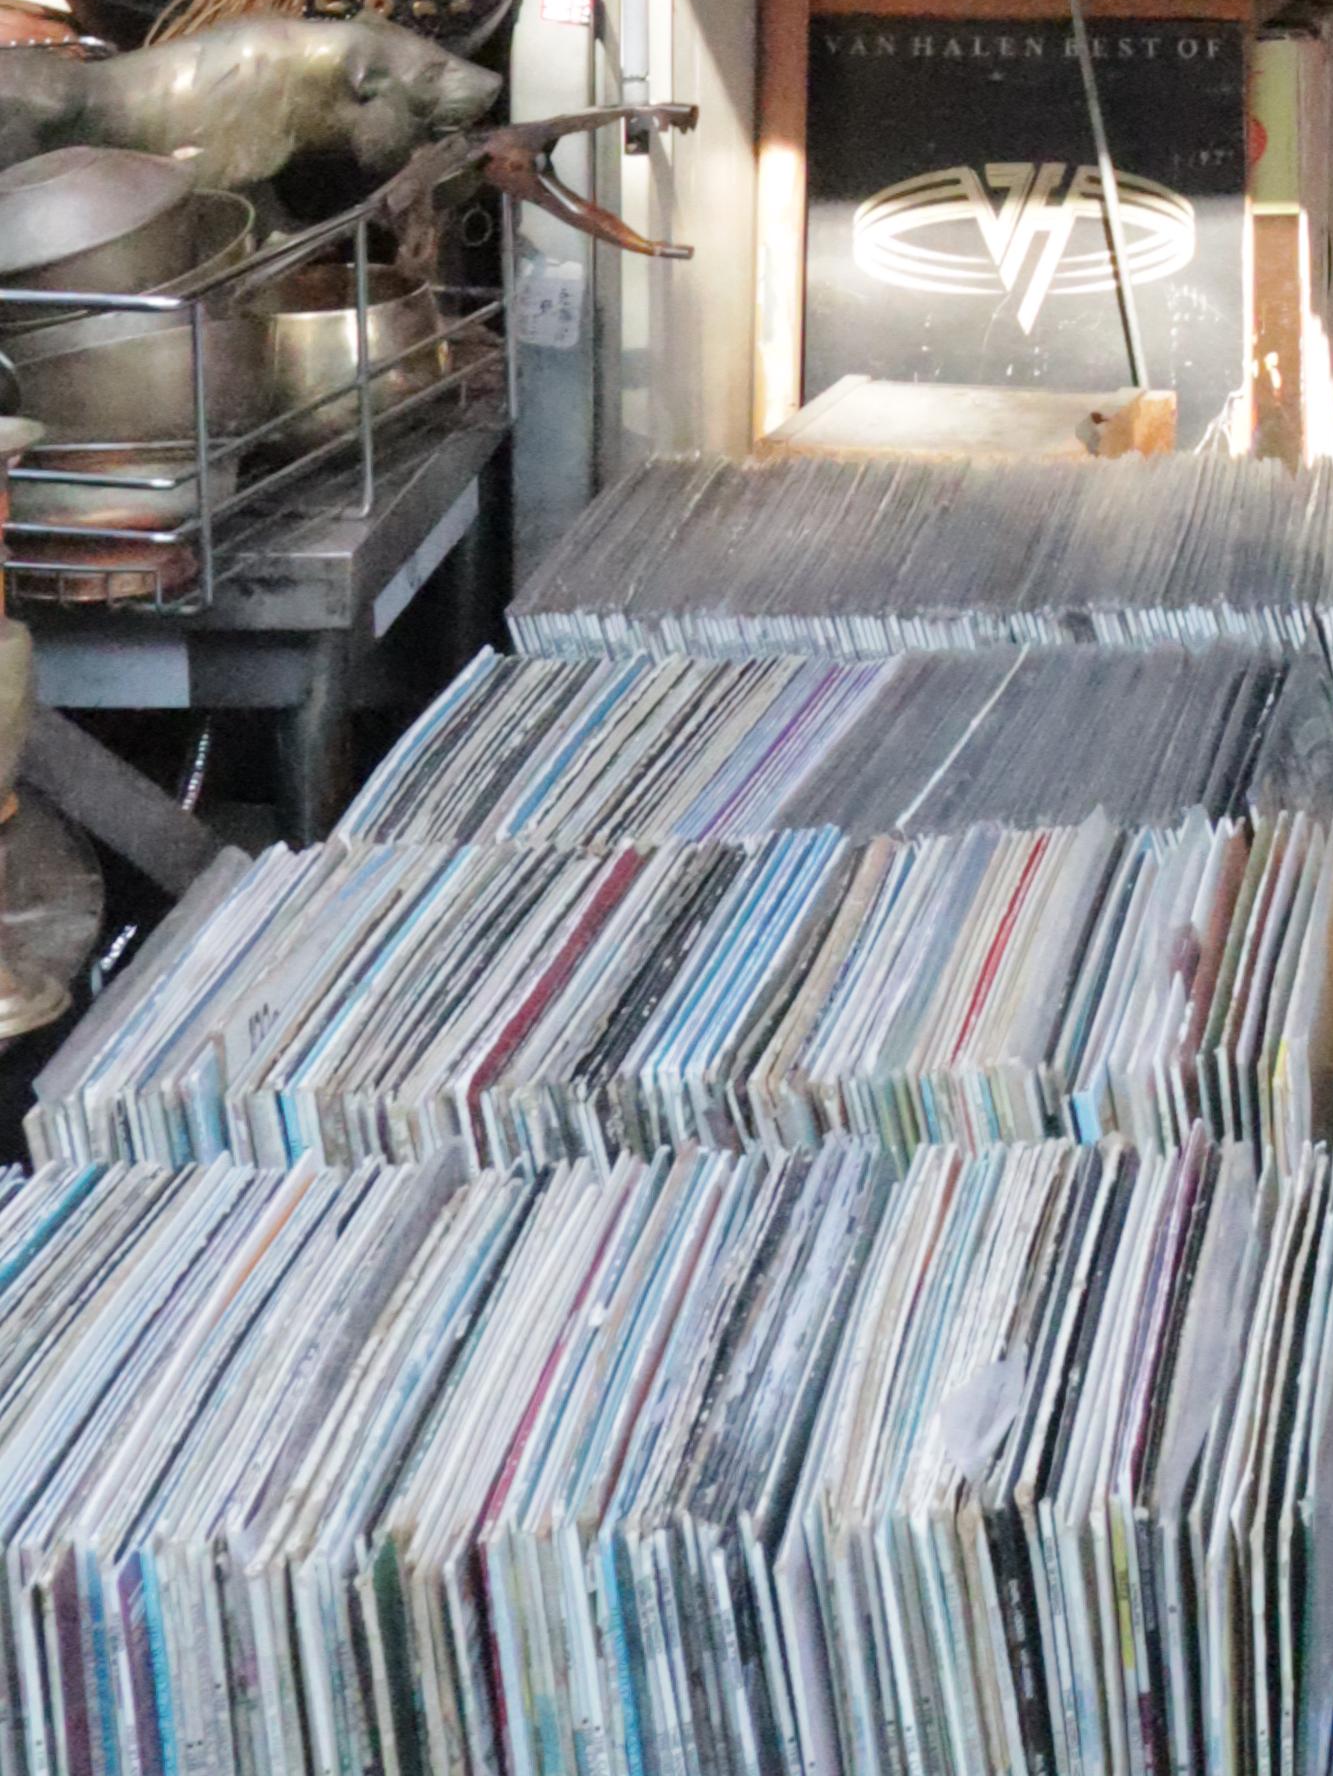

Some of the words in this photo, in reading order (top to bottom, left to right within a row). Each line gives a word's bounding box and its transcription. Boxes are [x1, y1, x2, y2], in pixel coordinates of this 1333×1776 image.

[824, 34, 897, 58] VAN
[913, 34, 1045, 58] HALEN
[1063, 35, 1161, 60] BEST
[1177, 36, 1223, 60] OF
